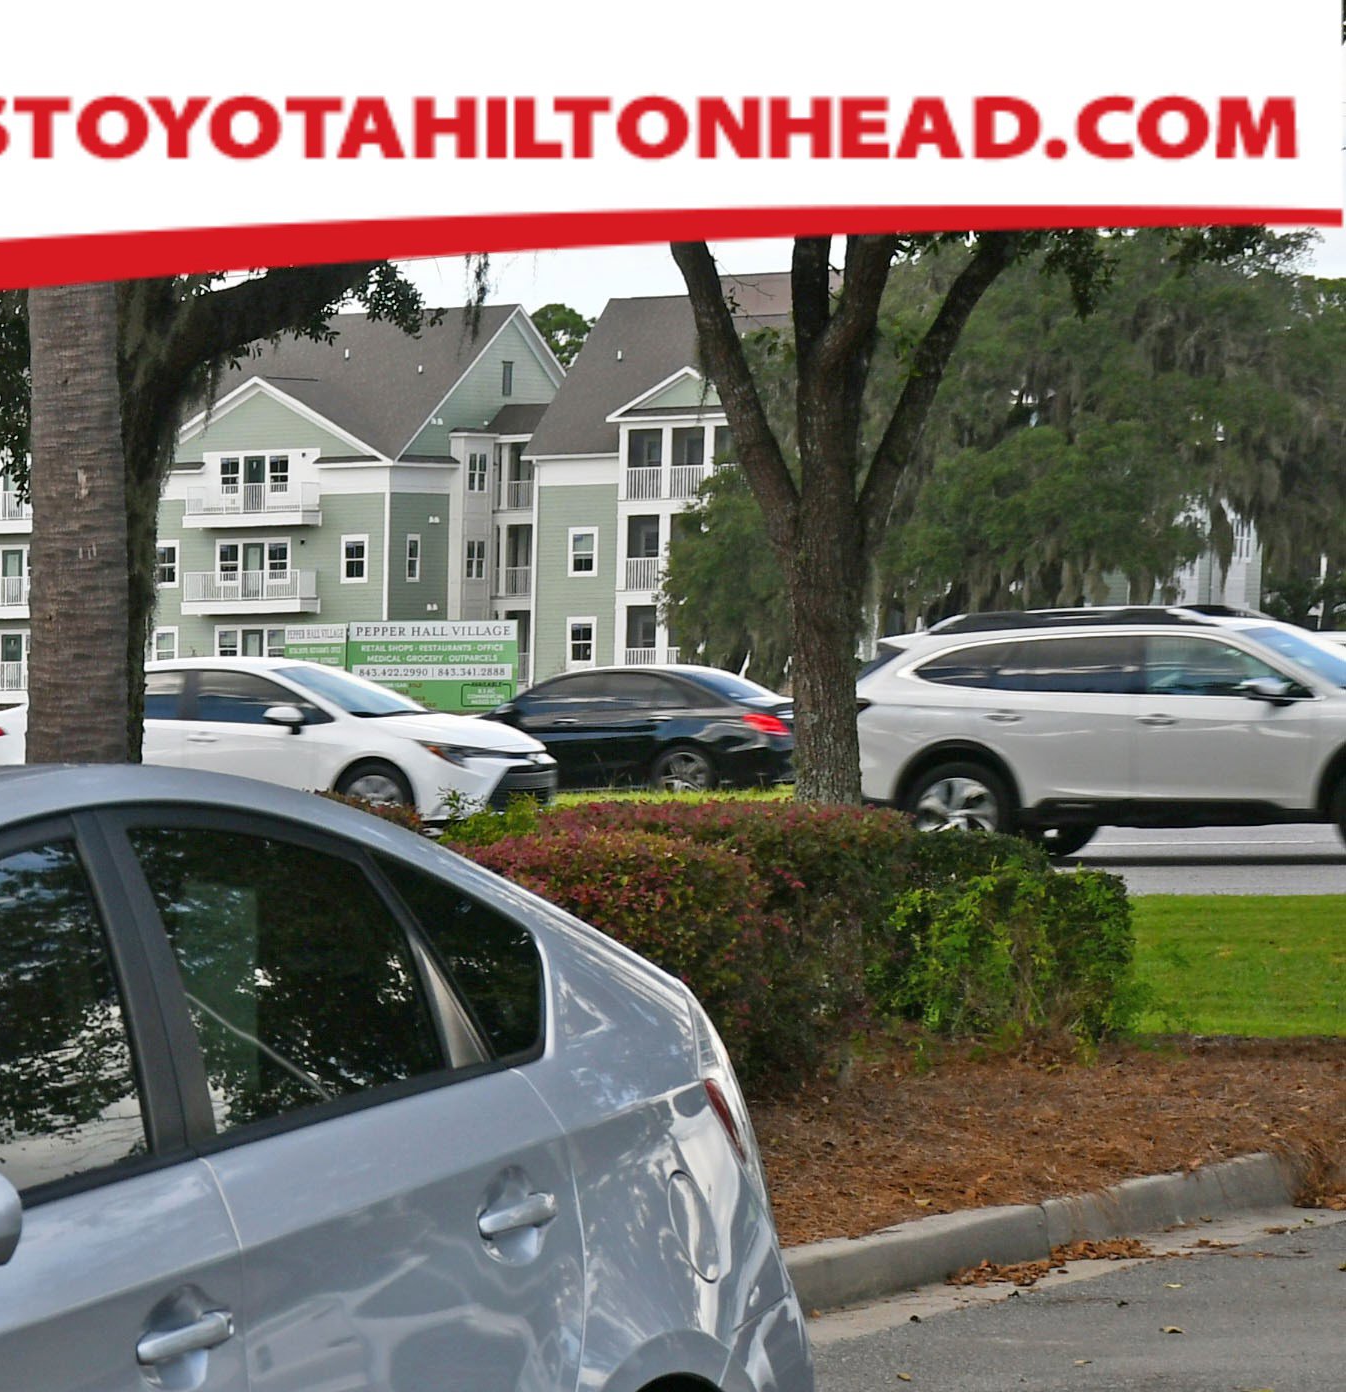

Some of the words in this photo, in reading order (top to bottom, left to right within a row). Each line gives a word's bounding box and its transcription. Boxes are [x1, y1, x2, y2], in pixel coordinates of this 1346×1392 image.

[356, 626, 406, 637] PEPPER
[411, 626, 448, 637] HALL
[452, 625, 511, 636] VILLAGE
[361, 644, 386, 652] RETAIL
[388, 644, 414, 652] SHOPS
[419, 644, 472, 652] RESTAURANTS
[448, 654, 498, 662] OUTPARCELS
[358, 668, 428, 677] 843.422.2990
[438, 667, 506, 676] 843.341.2888
